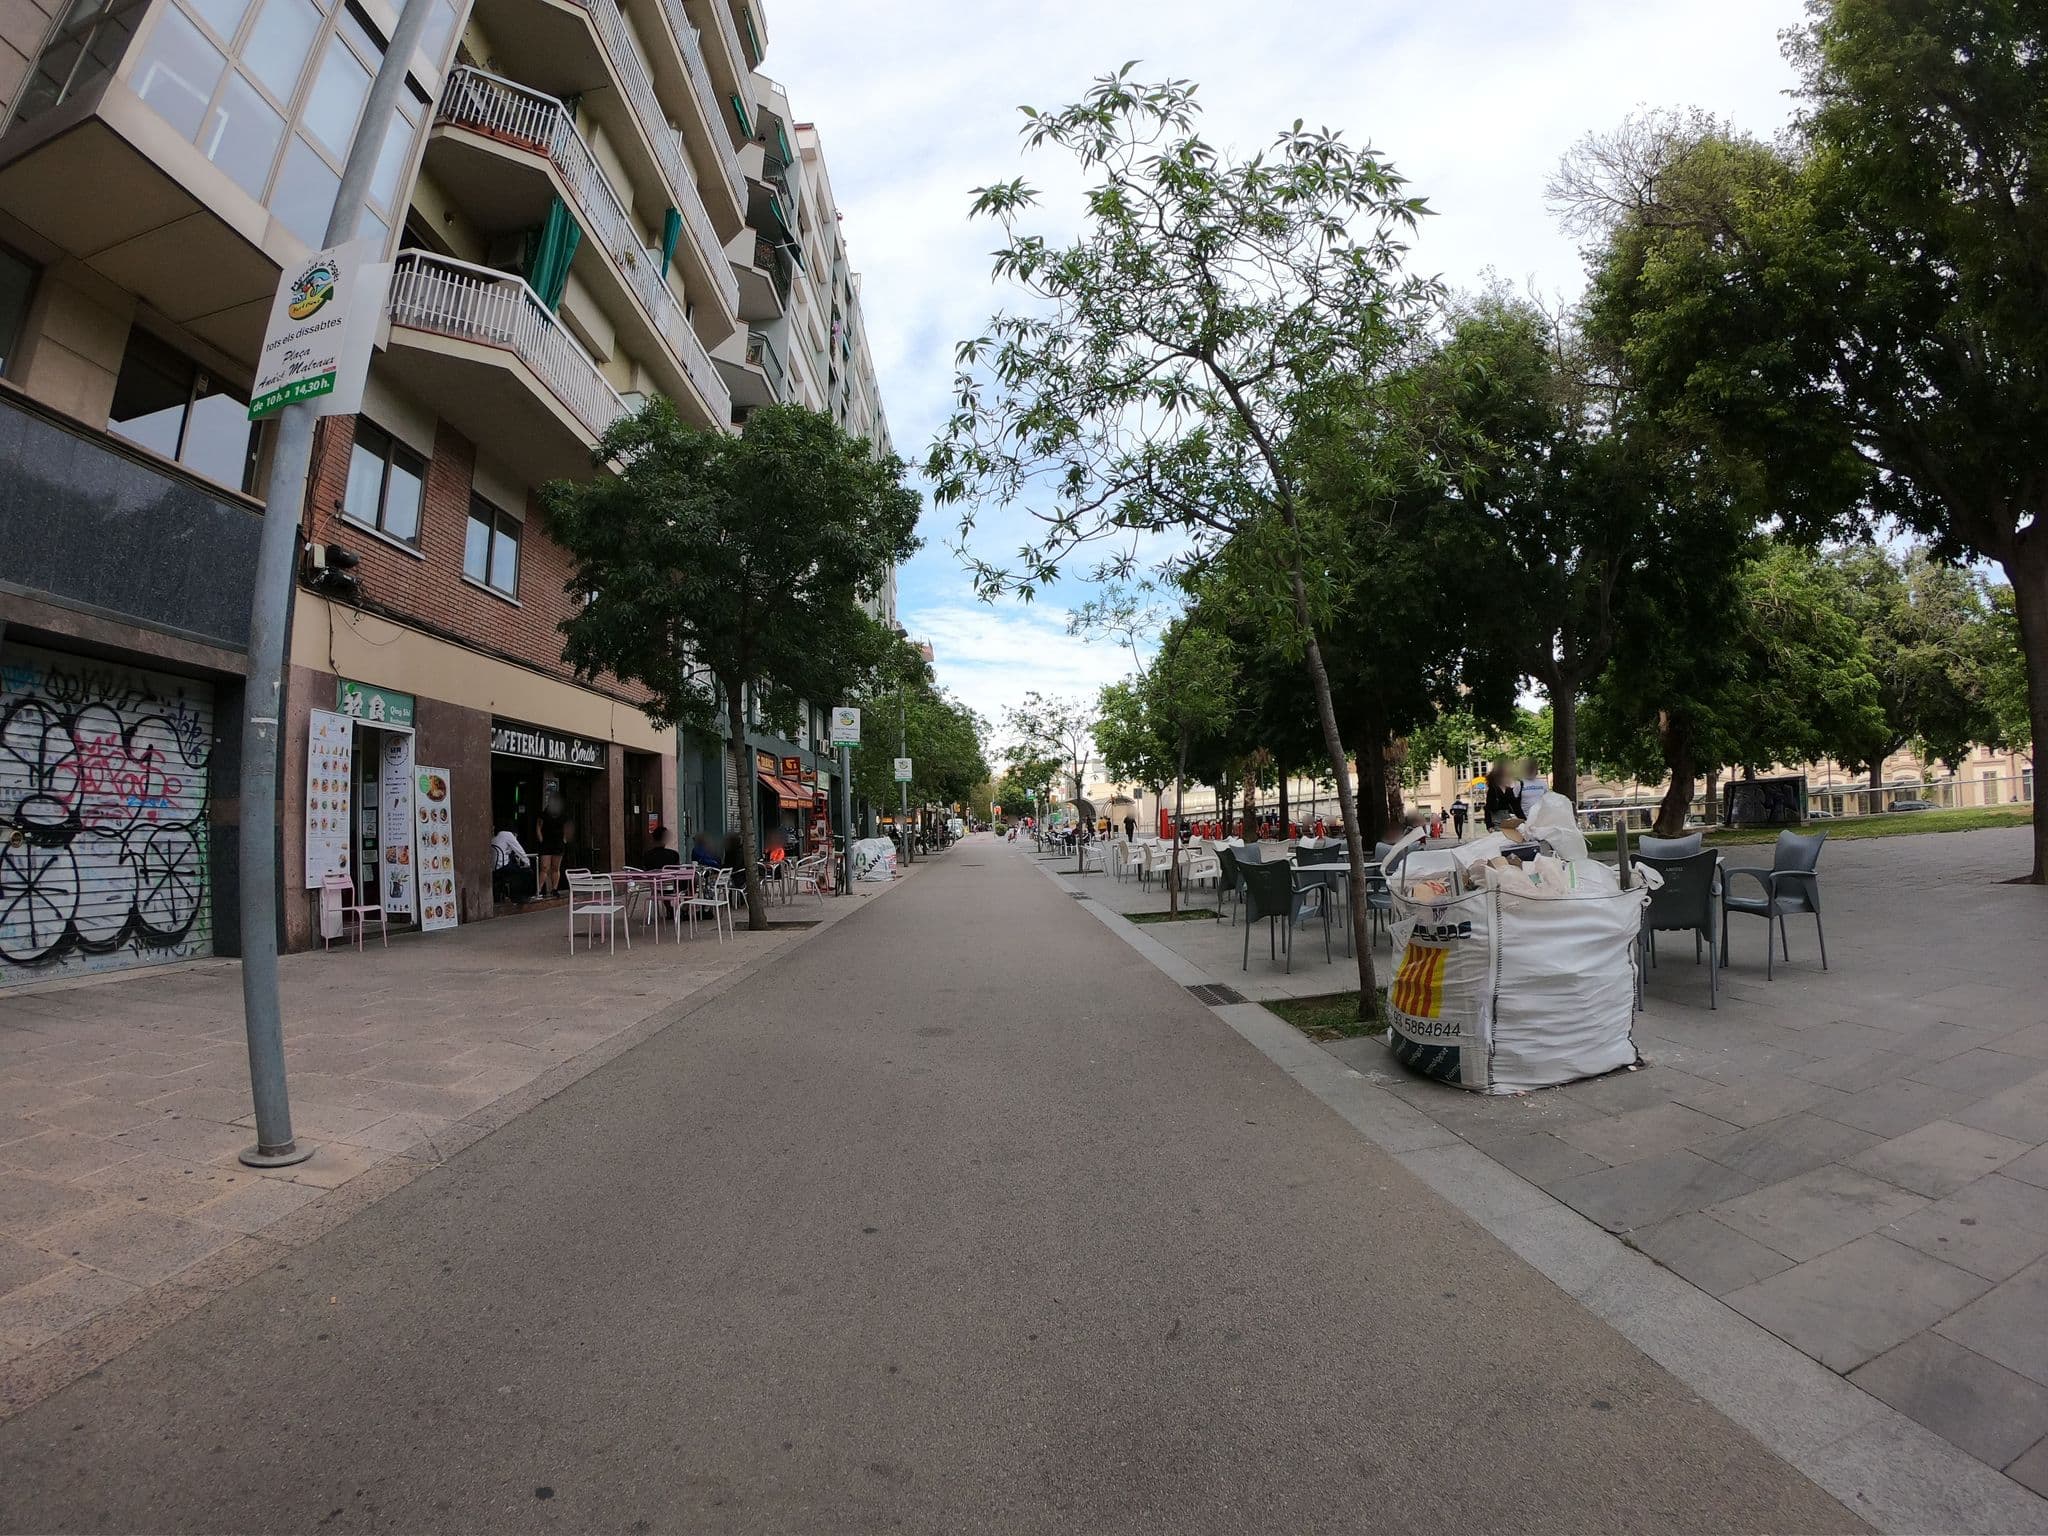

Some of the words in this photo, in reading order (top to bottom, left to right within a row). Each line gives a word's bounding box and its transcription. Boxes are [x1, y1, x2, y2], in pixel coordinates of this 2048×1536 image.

[282, 333, 294, 346] els
[295, 317, 342, 339] dissabtes
[548, 739, 566, 760] BAR
[1405, 1018, 1461, 1037] 5864644
